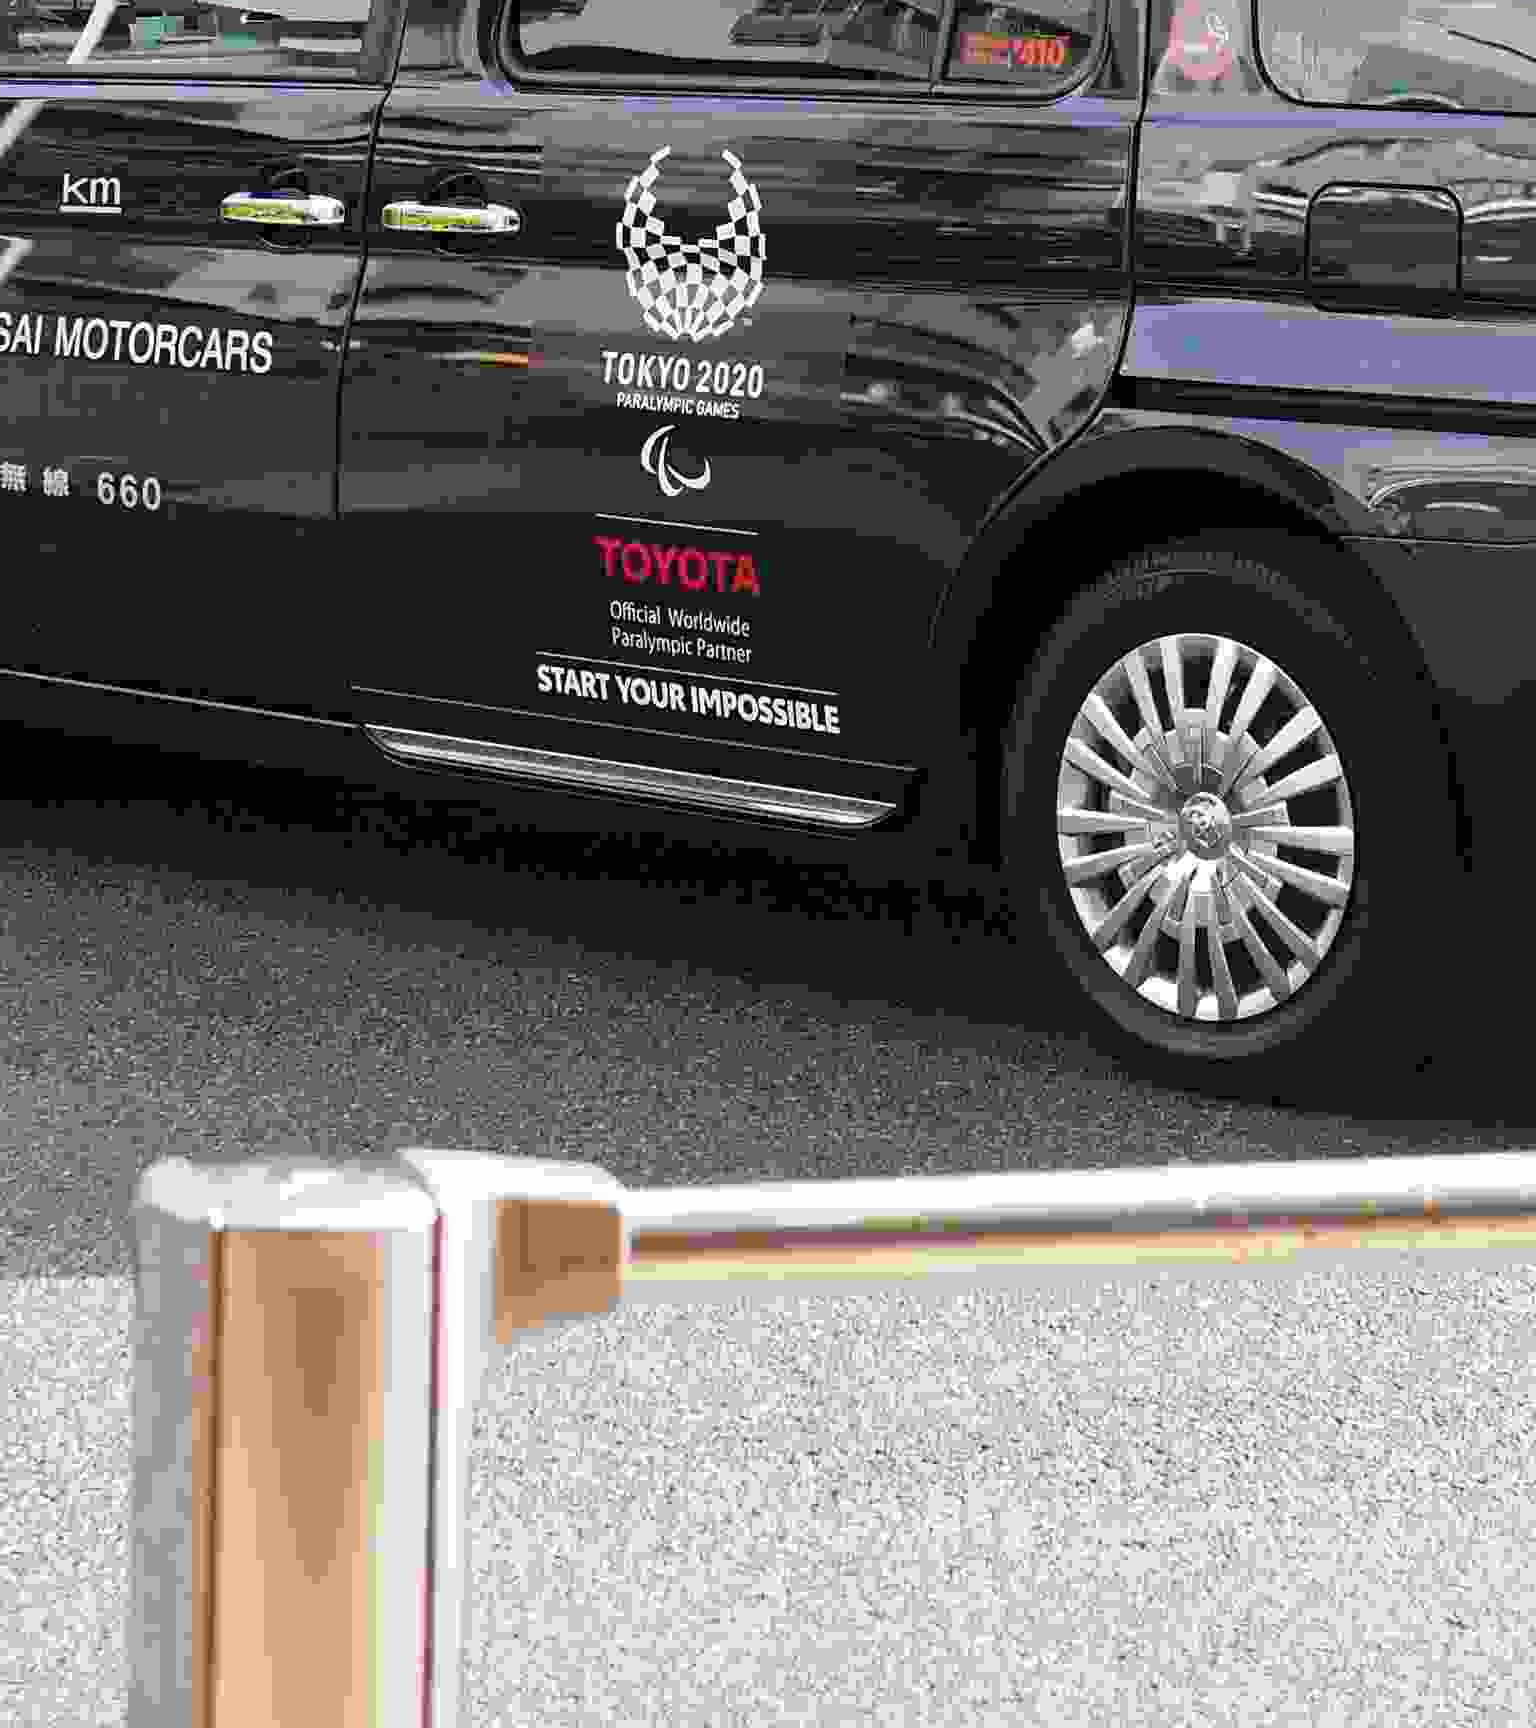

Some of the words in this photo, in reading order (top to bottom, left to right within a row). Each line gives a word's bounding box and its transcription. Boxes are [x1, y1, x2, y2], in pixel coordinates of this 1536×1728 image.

[62, 172, 122, 206] km
[54, 315, 274, 374] MOTORCARS
[602, 351, 691, 391] TOKYO
[695, 359, 764, 399] 2020
[615, 390, 694, 415] PARALYMPIC
[695, 399, 741, 420] GAMES
[95, 471, 162, 512] 660
[592, 535, 761, 595] TOYOTA
[609, 599, 662, 626] Official
[667, 608, 752, 639] Worldwide
[611, 625, 694, 657] Paralympic
[696, 636, 753, 665] Partner
[535, 663, 610, 701] START
[615, 673, 687, 712] YOUR
[690, 684, 841, 735] IMPOSSIBLE
